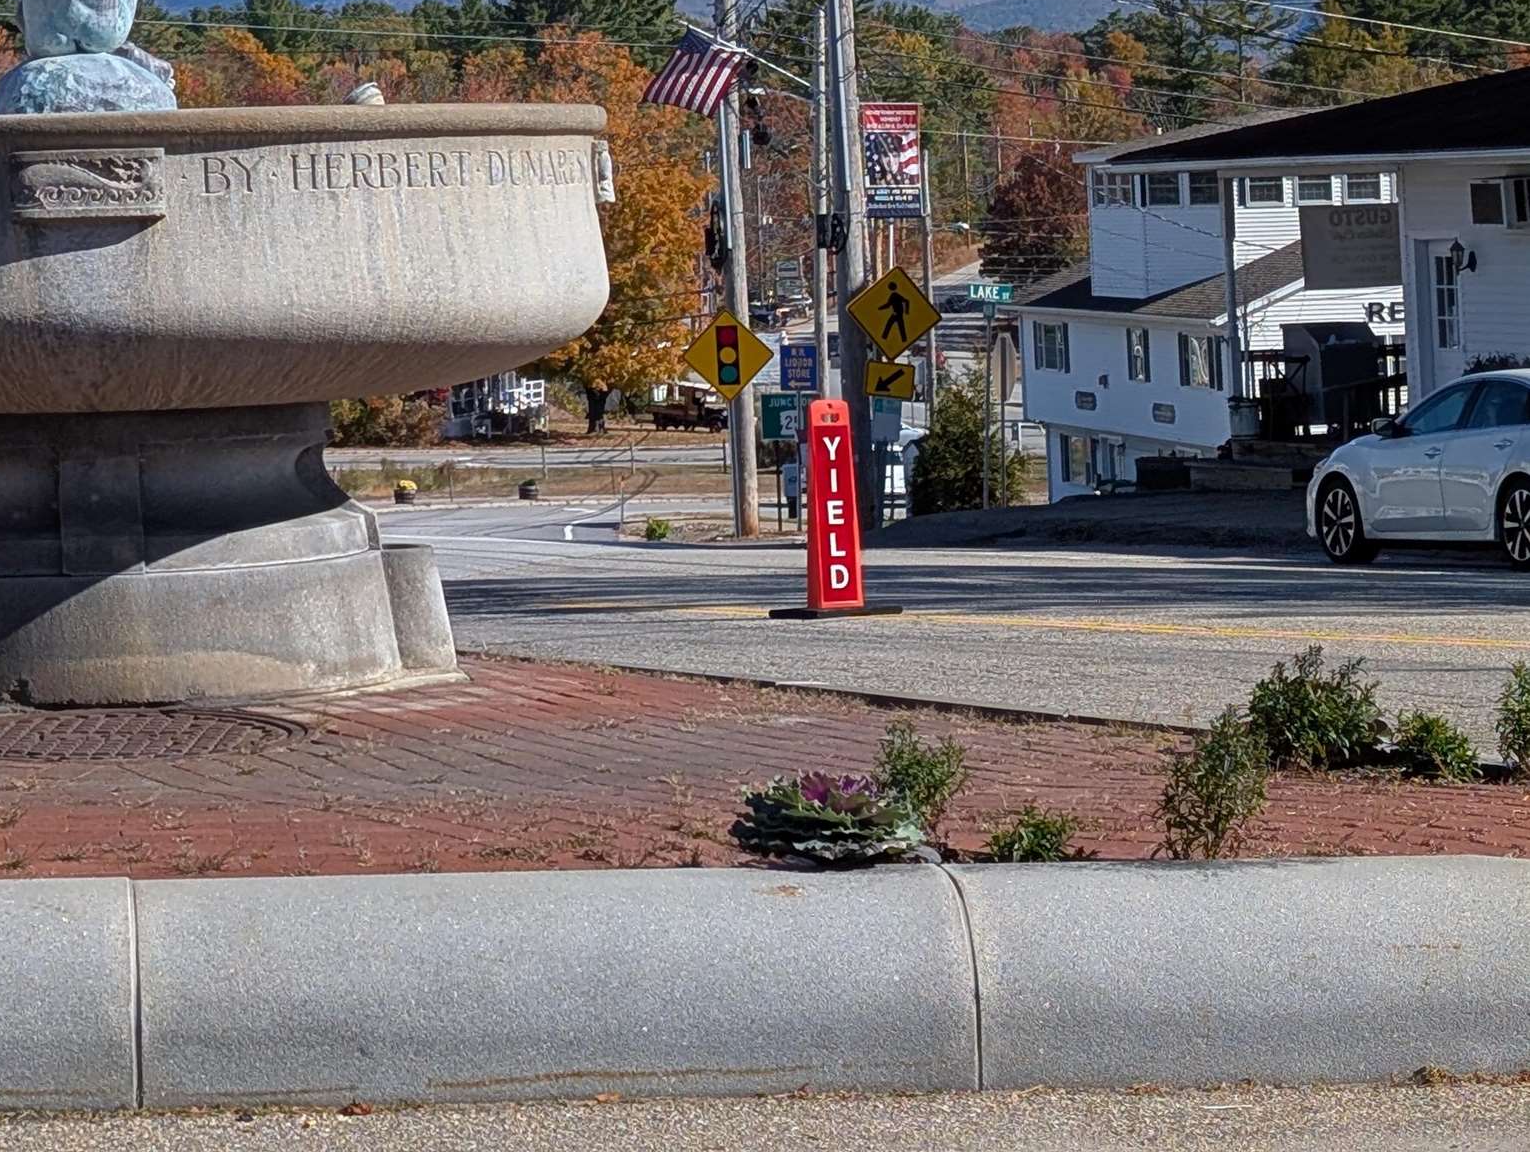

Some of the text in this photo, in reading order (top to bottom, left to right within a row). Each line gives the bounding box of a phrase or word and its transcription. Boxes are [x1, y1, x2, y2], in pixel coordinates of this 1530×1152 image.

[201, 156, 265, 195] BY
[290, 150, 472, 192] HERBERT
[970, 285, 999, 299] LAKE
[788, 369, 812, 379] STORE
[768, 397, 811, 408] JUNCO
[823, 436, 849, 589] YIELD
